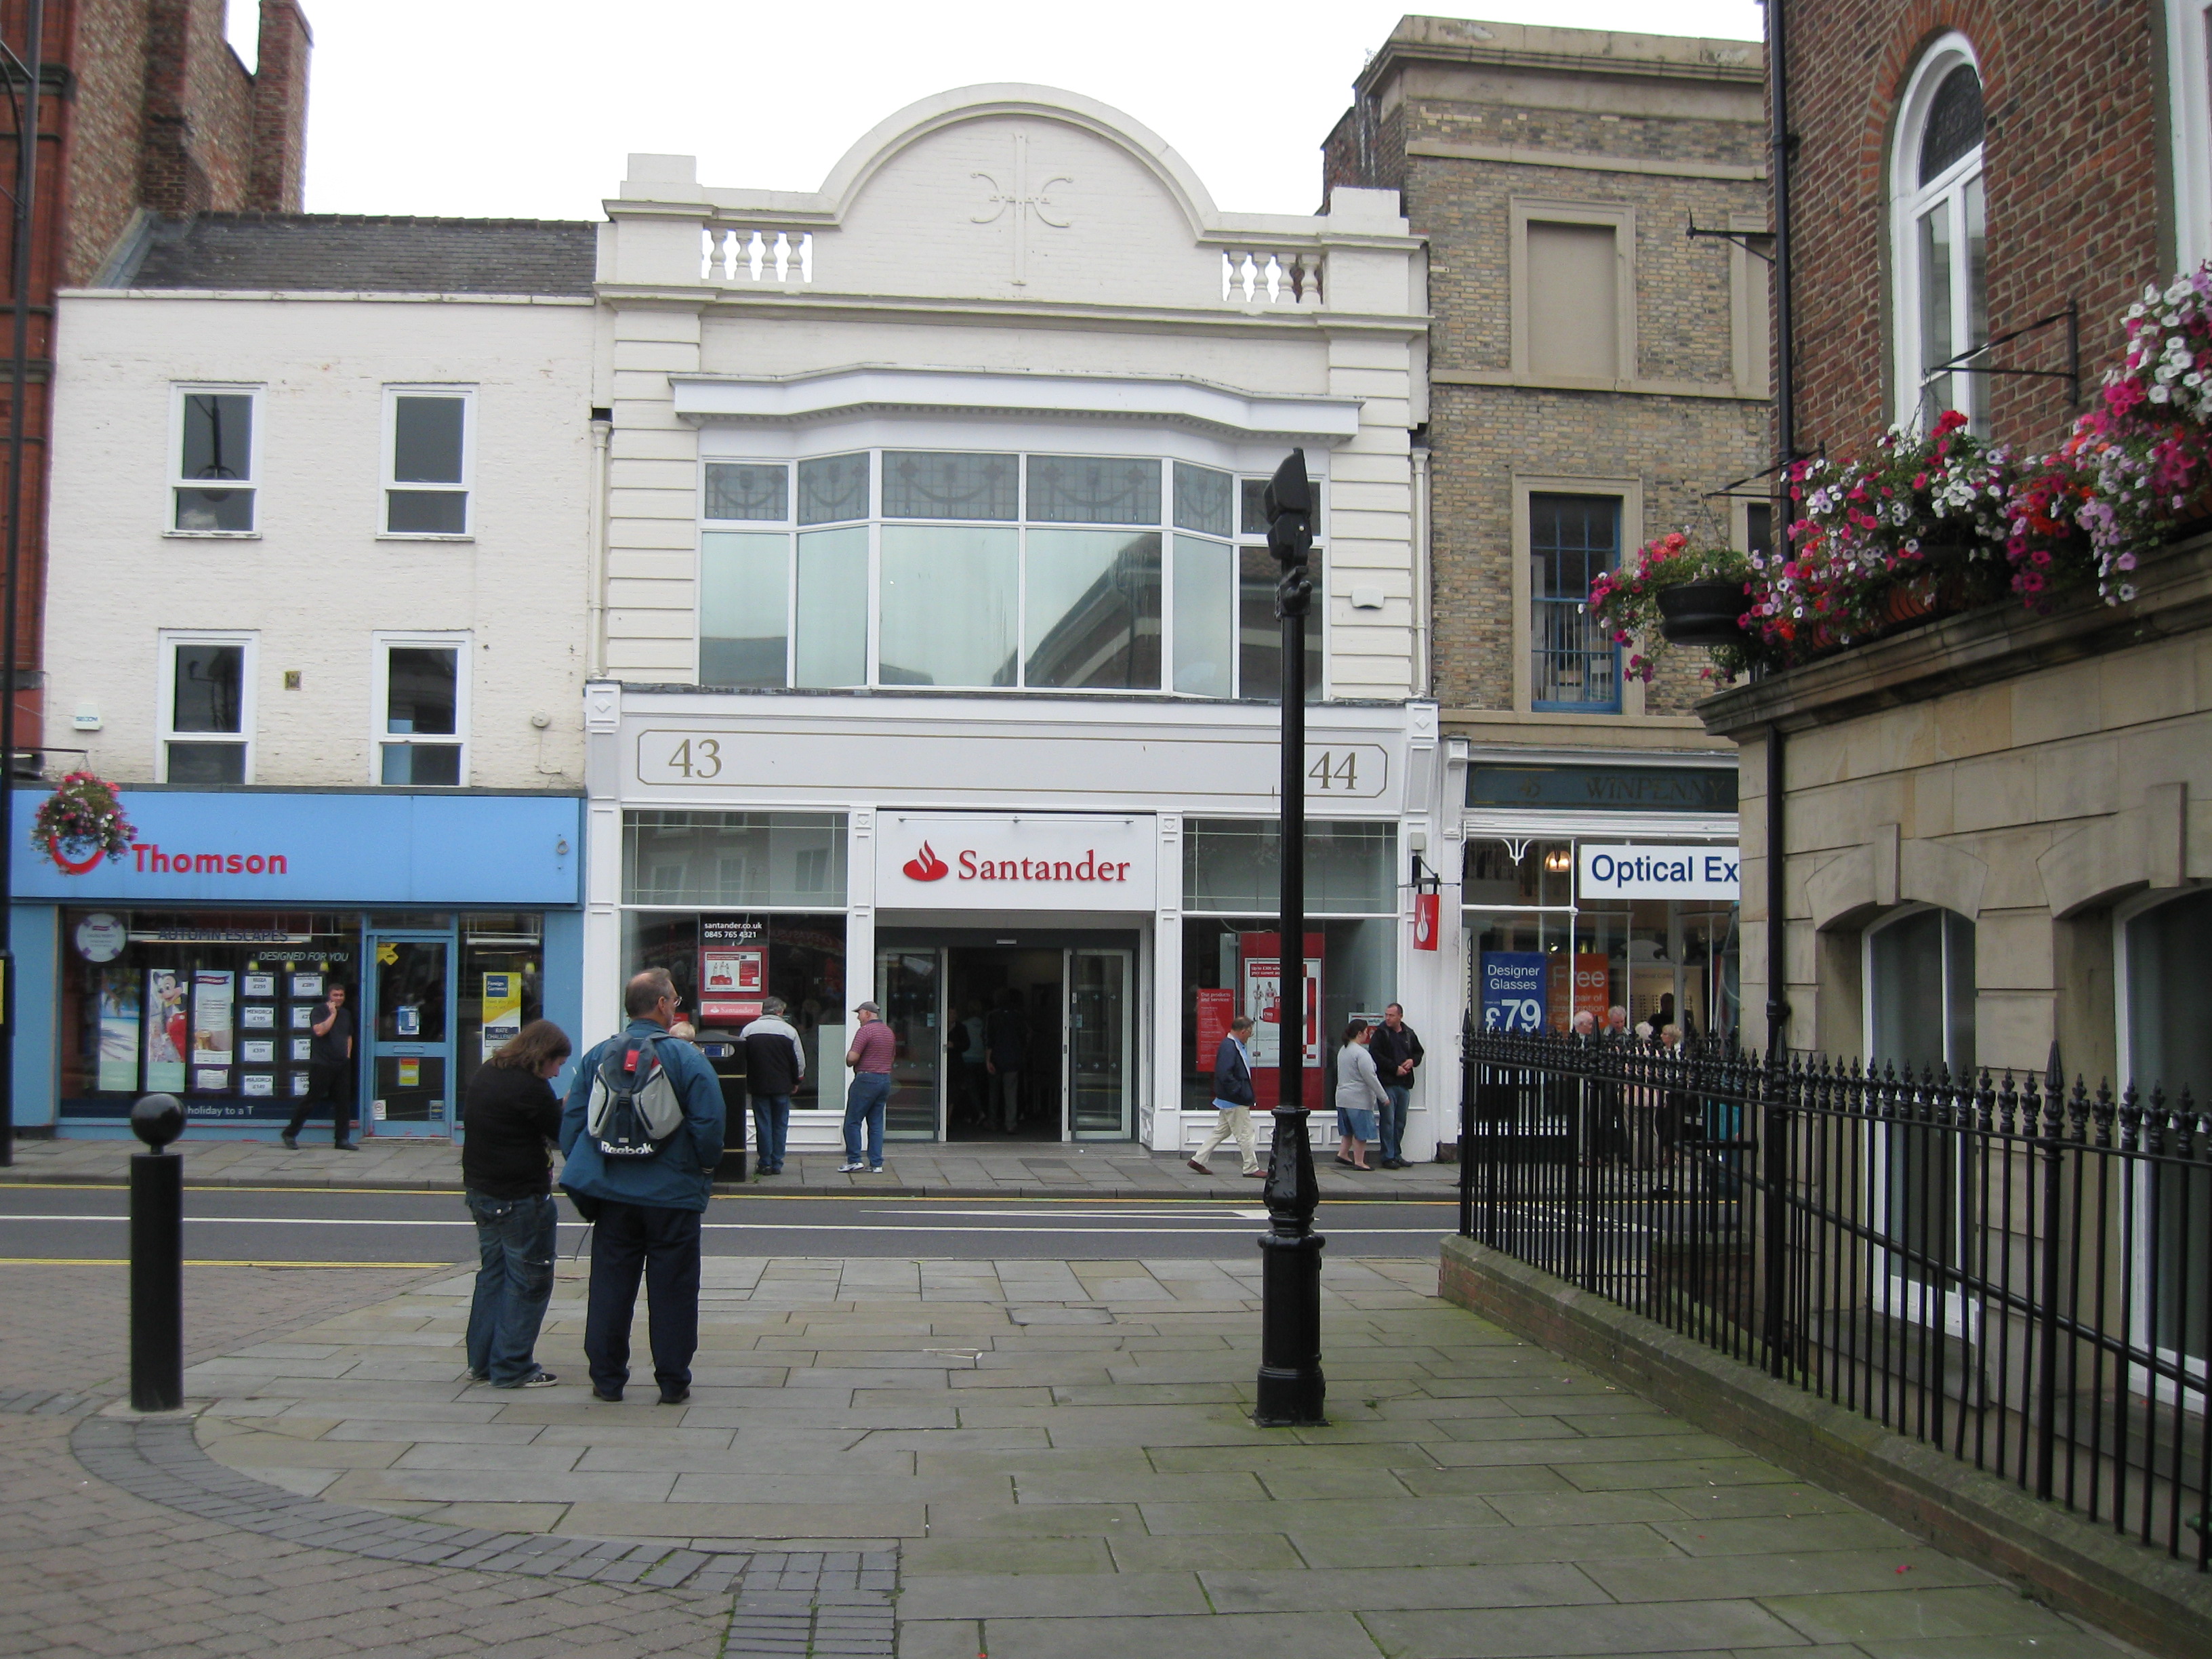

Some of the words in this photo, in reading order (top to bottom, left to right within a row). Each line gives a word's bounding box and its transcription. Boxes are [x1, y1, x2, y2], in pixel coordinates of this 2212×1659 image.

[668, 739, 722, 779] 43
[1308, 751, 1357, 790] 44
[131, 844, 288, 874] Thomson
[958, 848, 1131, 882] Santander
[1591, 854, 1693, 888] Optical
[1704, 857, 1739, 882] Ex
[159, 928, 221, 941] AUTUMN
[226, 929, 288, 942] ESCAPES
[260, 951, 305, 961] DESIGNED
[307, 951, 327, 961] FOR
[329, 952, 349, 962] YOU
[1488, 964, 1540, 978] Designer
[1553, 964, 1605, 987] Fee
[1490, 978, 1537, 989] Glasses
[1485, 999, 1541, 1033] £79
[188, 1105, 222, 1117] holiday
[226, 1107, 236, 1115] to
[247, 1106, 254, 1115] T
[600, 1140, 654, 1155] Reebok
